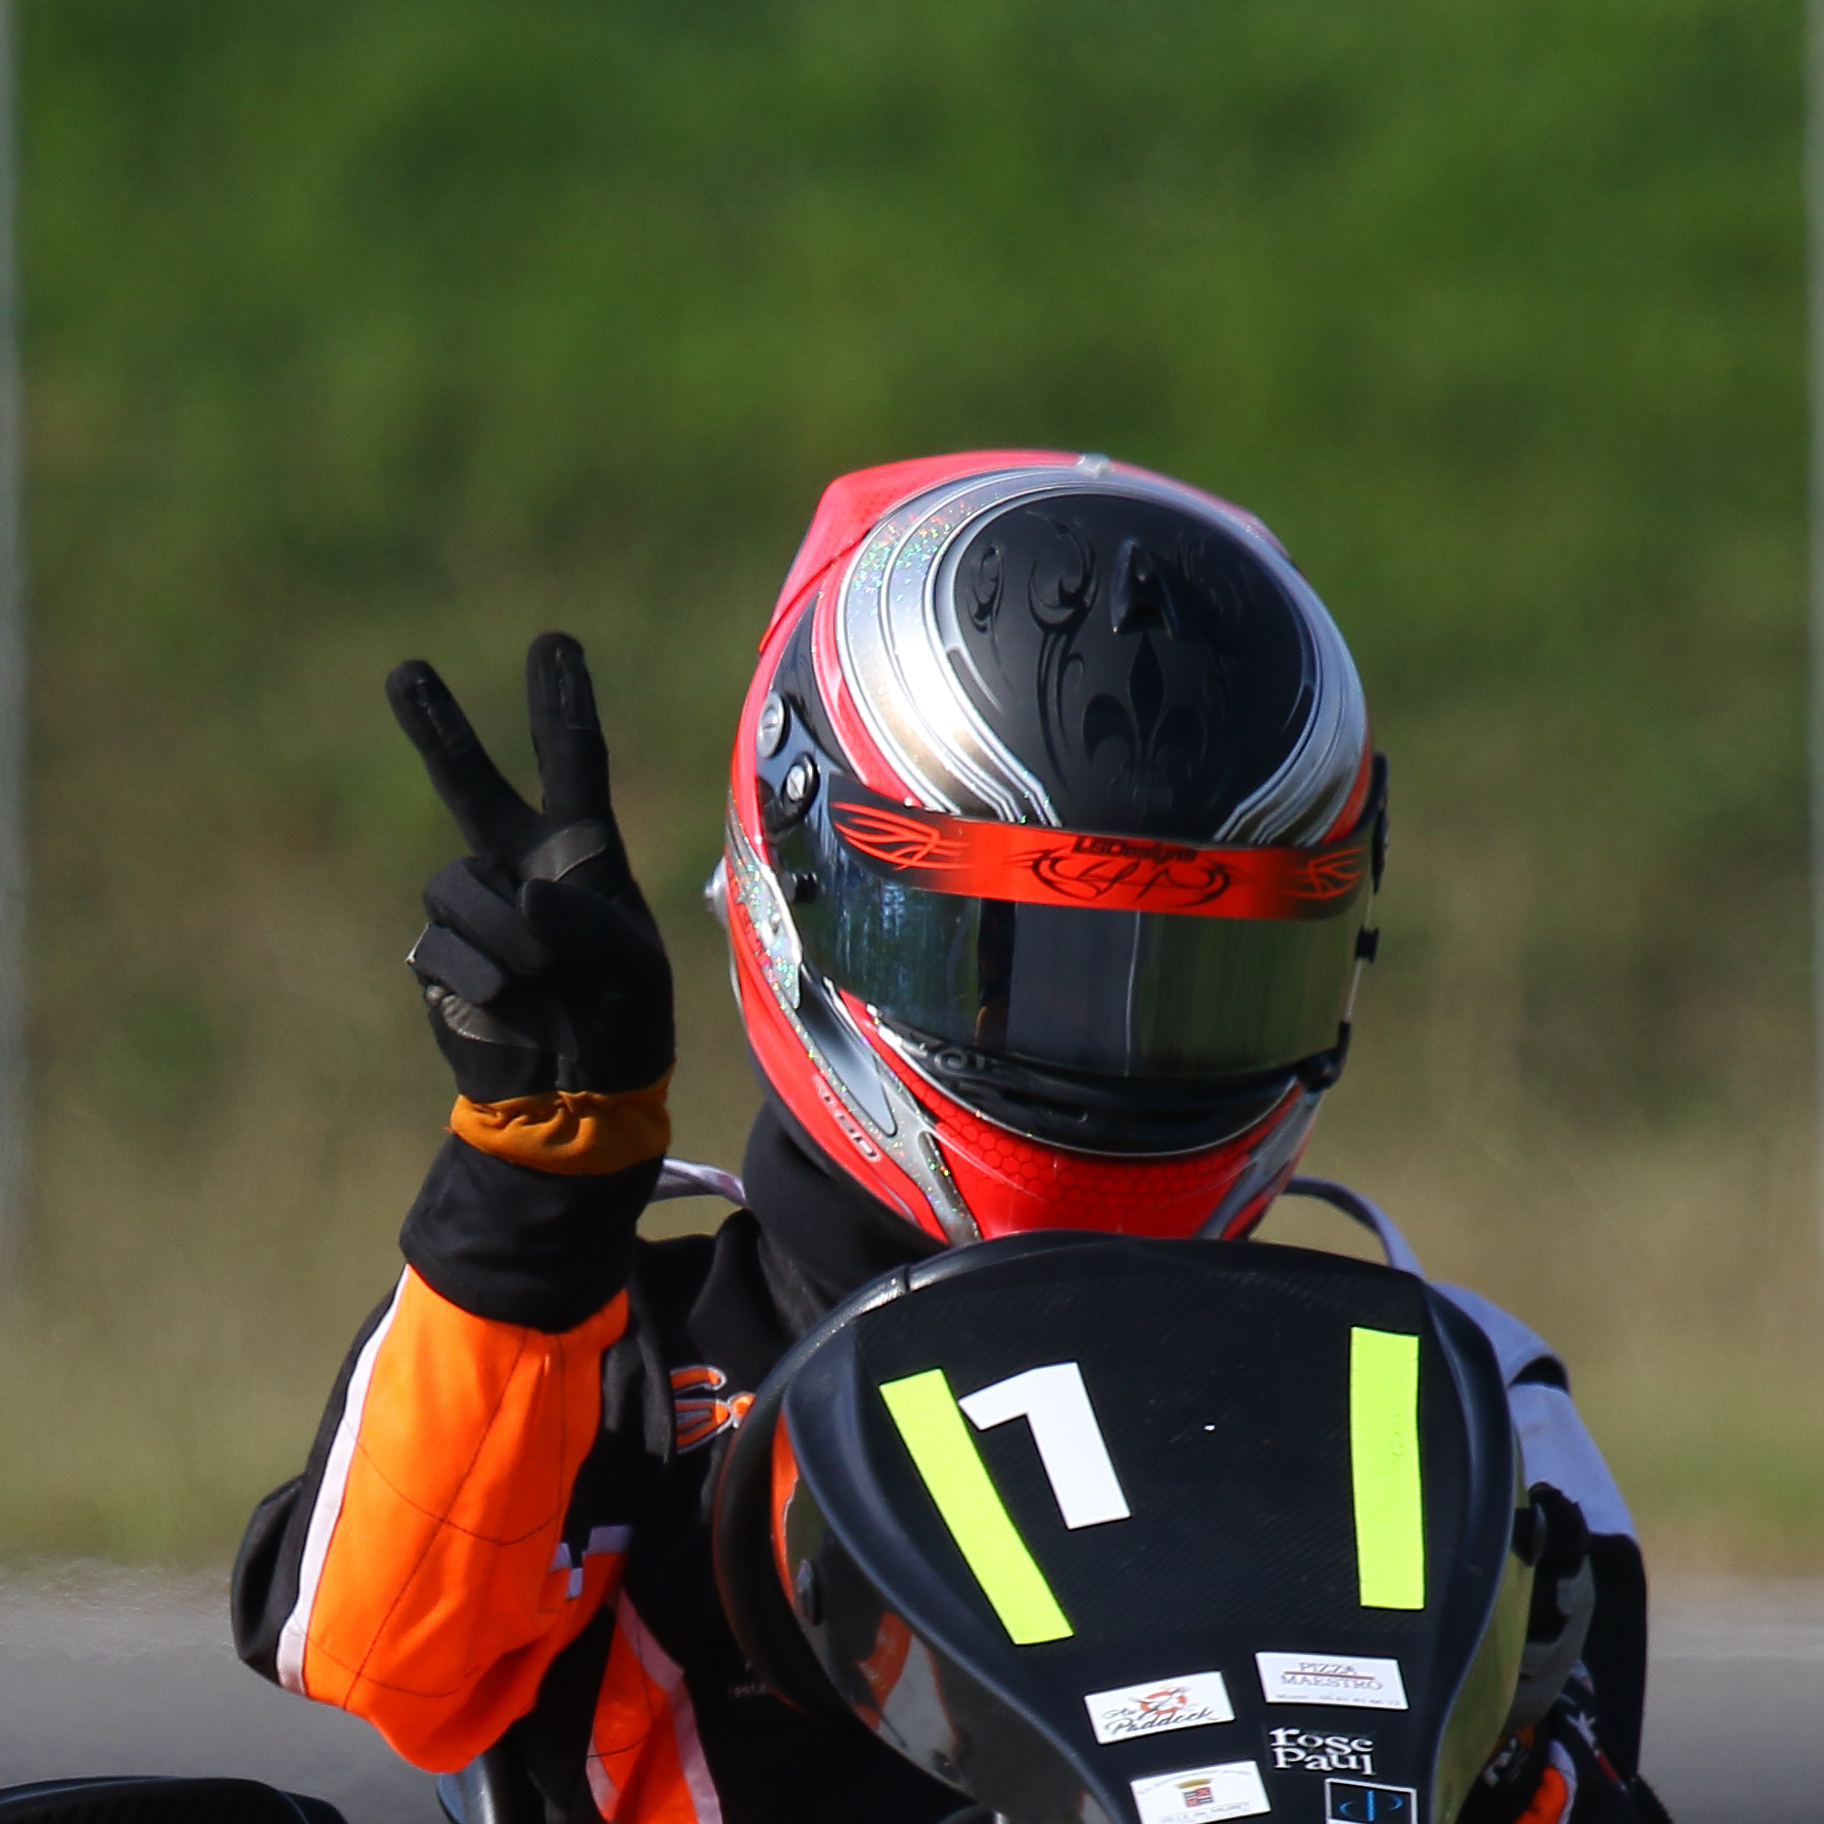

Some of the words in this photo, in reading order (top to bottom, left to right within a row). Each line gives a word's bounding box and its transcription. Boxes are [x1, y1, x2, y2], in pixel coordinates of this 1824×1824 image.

[959, 1361, 1131, 1531] 1
[1299, 1662, 1358, 1674] PIZZA
[1281, 1675, 1384, 1691] MAESTRO
[1103, 1707, 1222, 1736] Paddock
